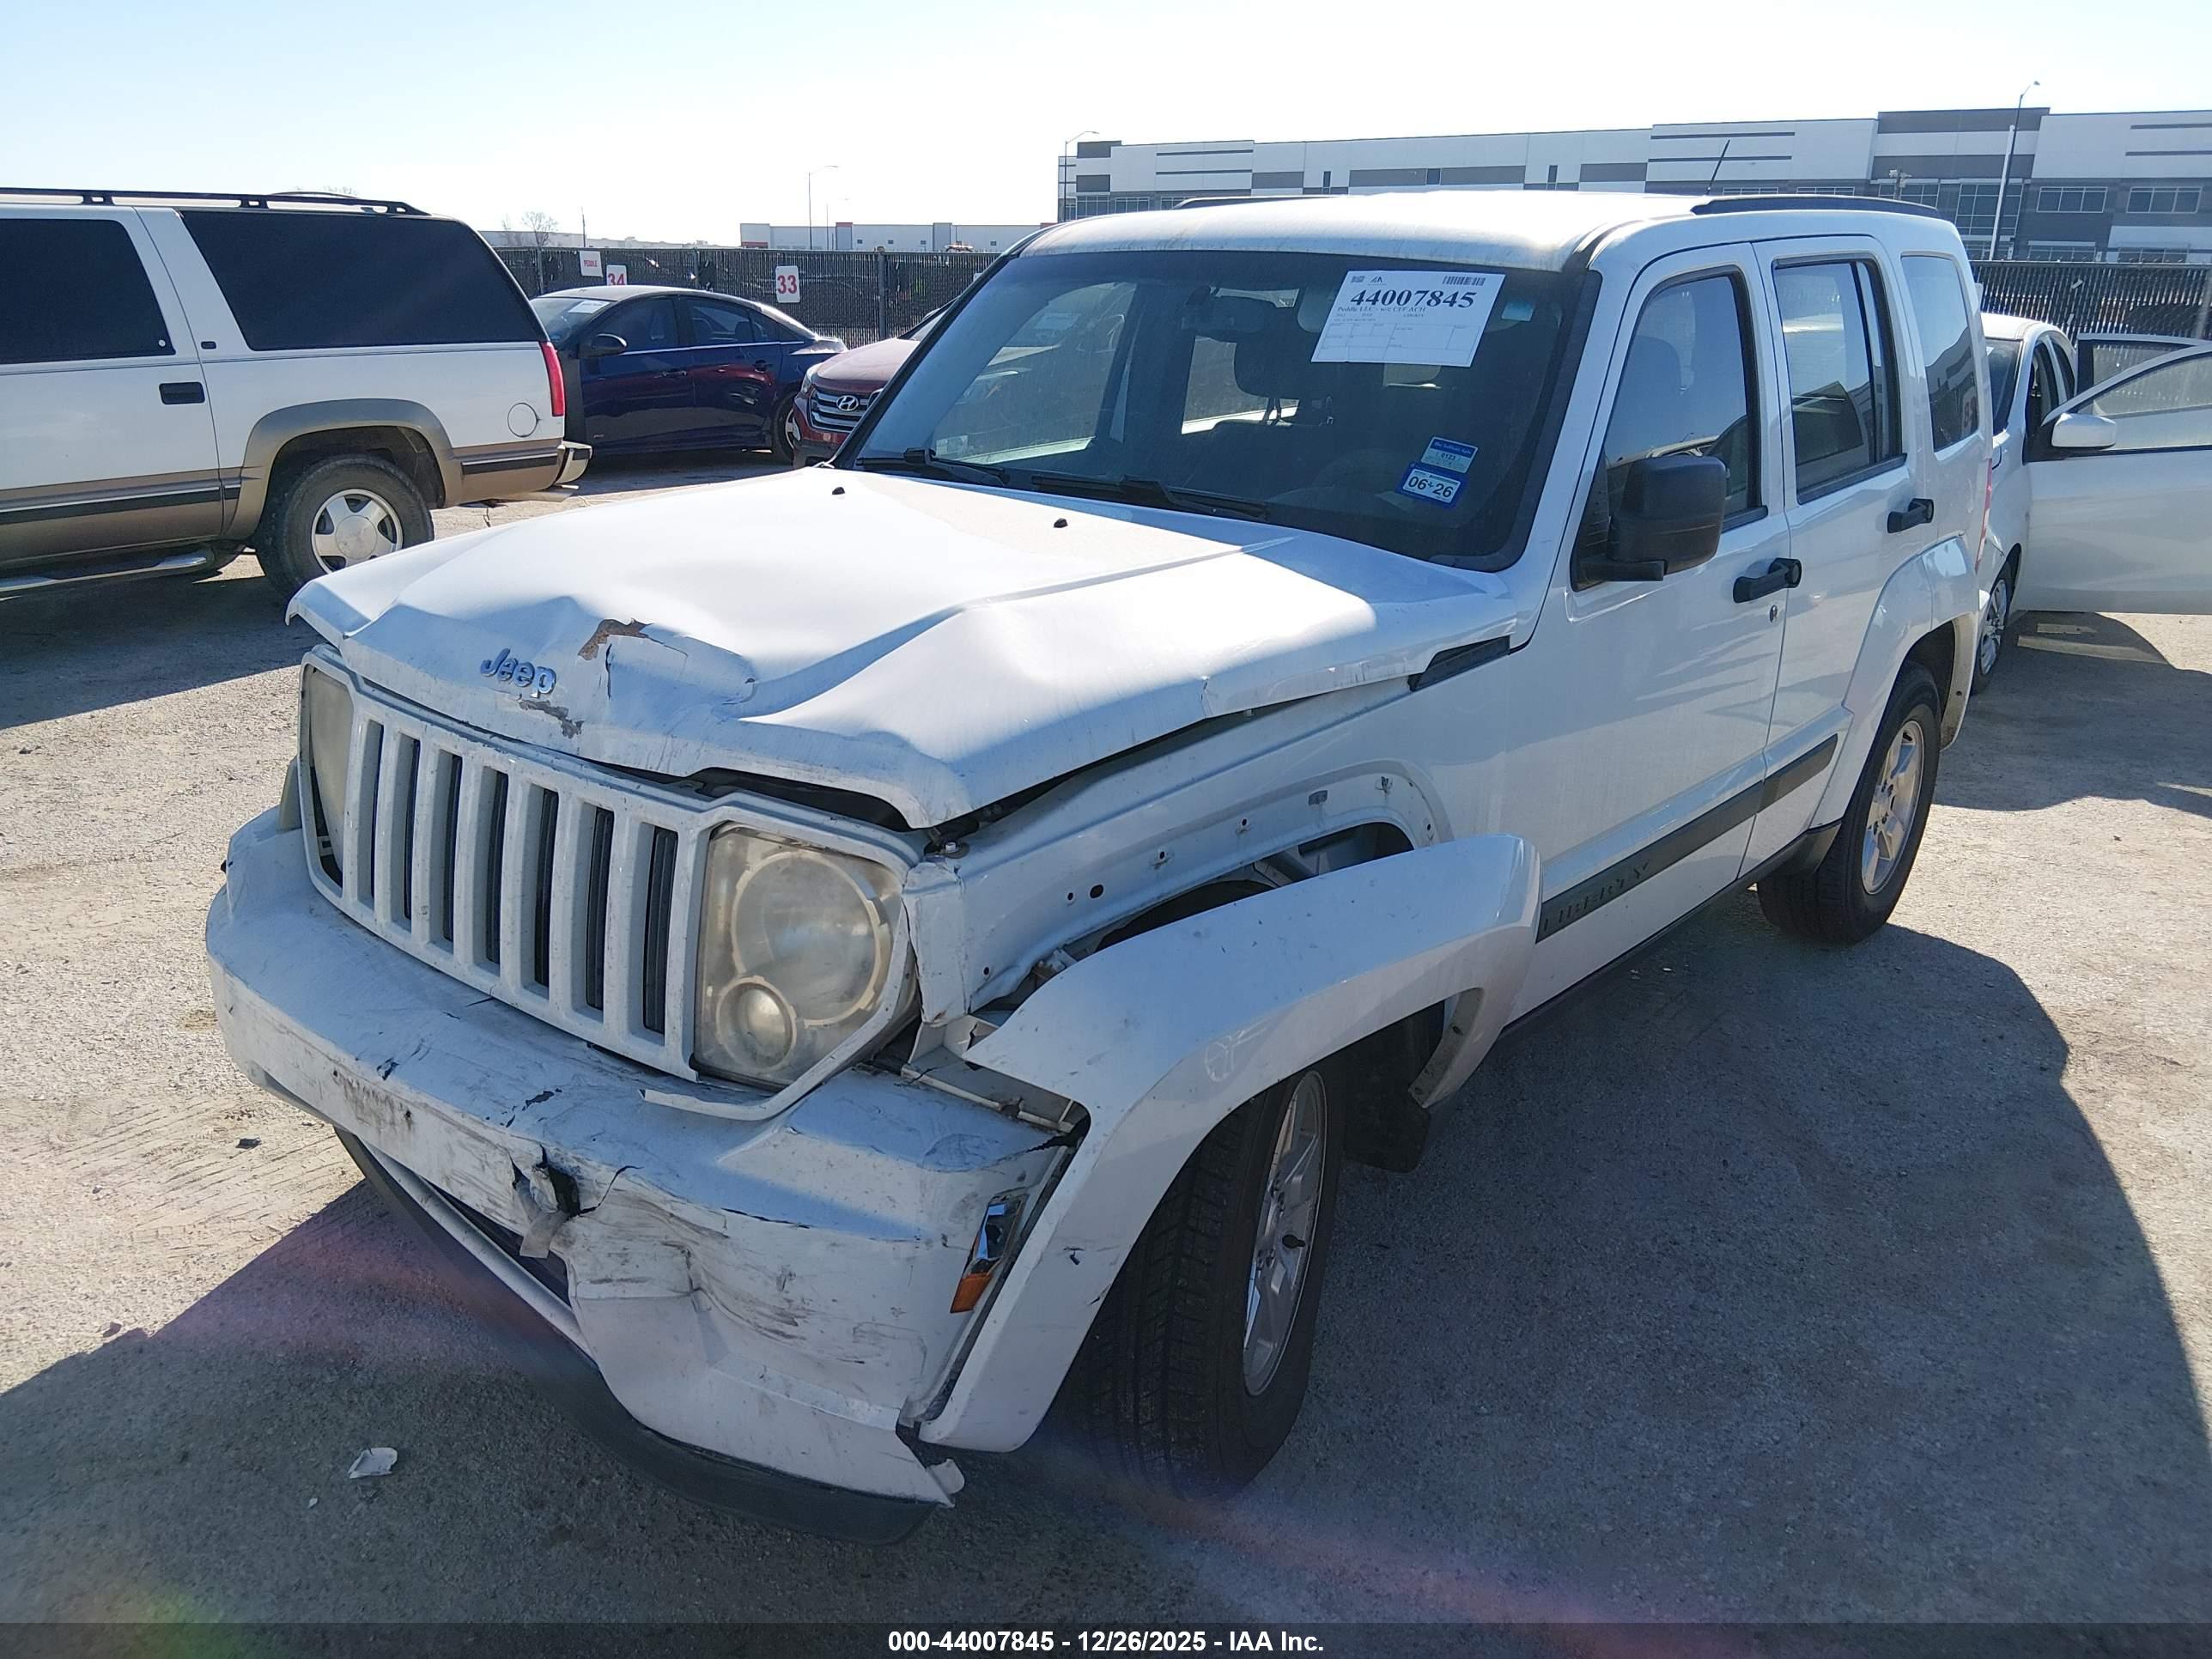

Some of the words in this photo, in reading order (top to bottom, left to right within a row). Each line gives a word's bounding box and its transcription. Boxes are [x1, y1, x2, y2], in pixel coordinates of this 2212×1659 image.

[777, 275, 798, 294] 33
[1350, 289, 1477, 307] 44007845
[1408, 476, 1428, 490] 06
[1433, 483, 1454, 498] 26
[480, 647, 556, 698] Jeep
